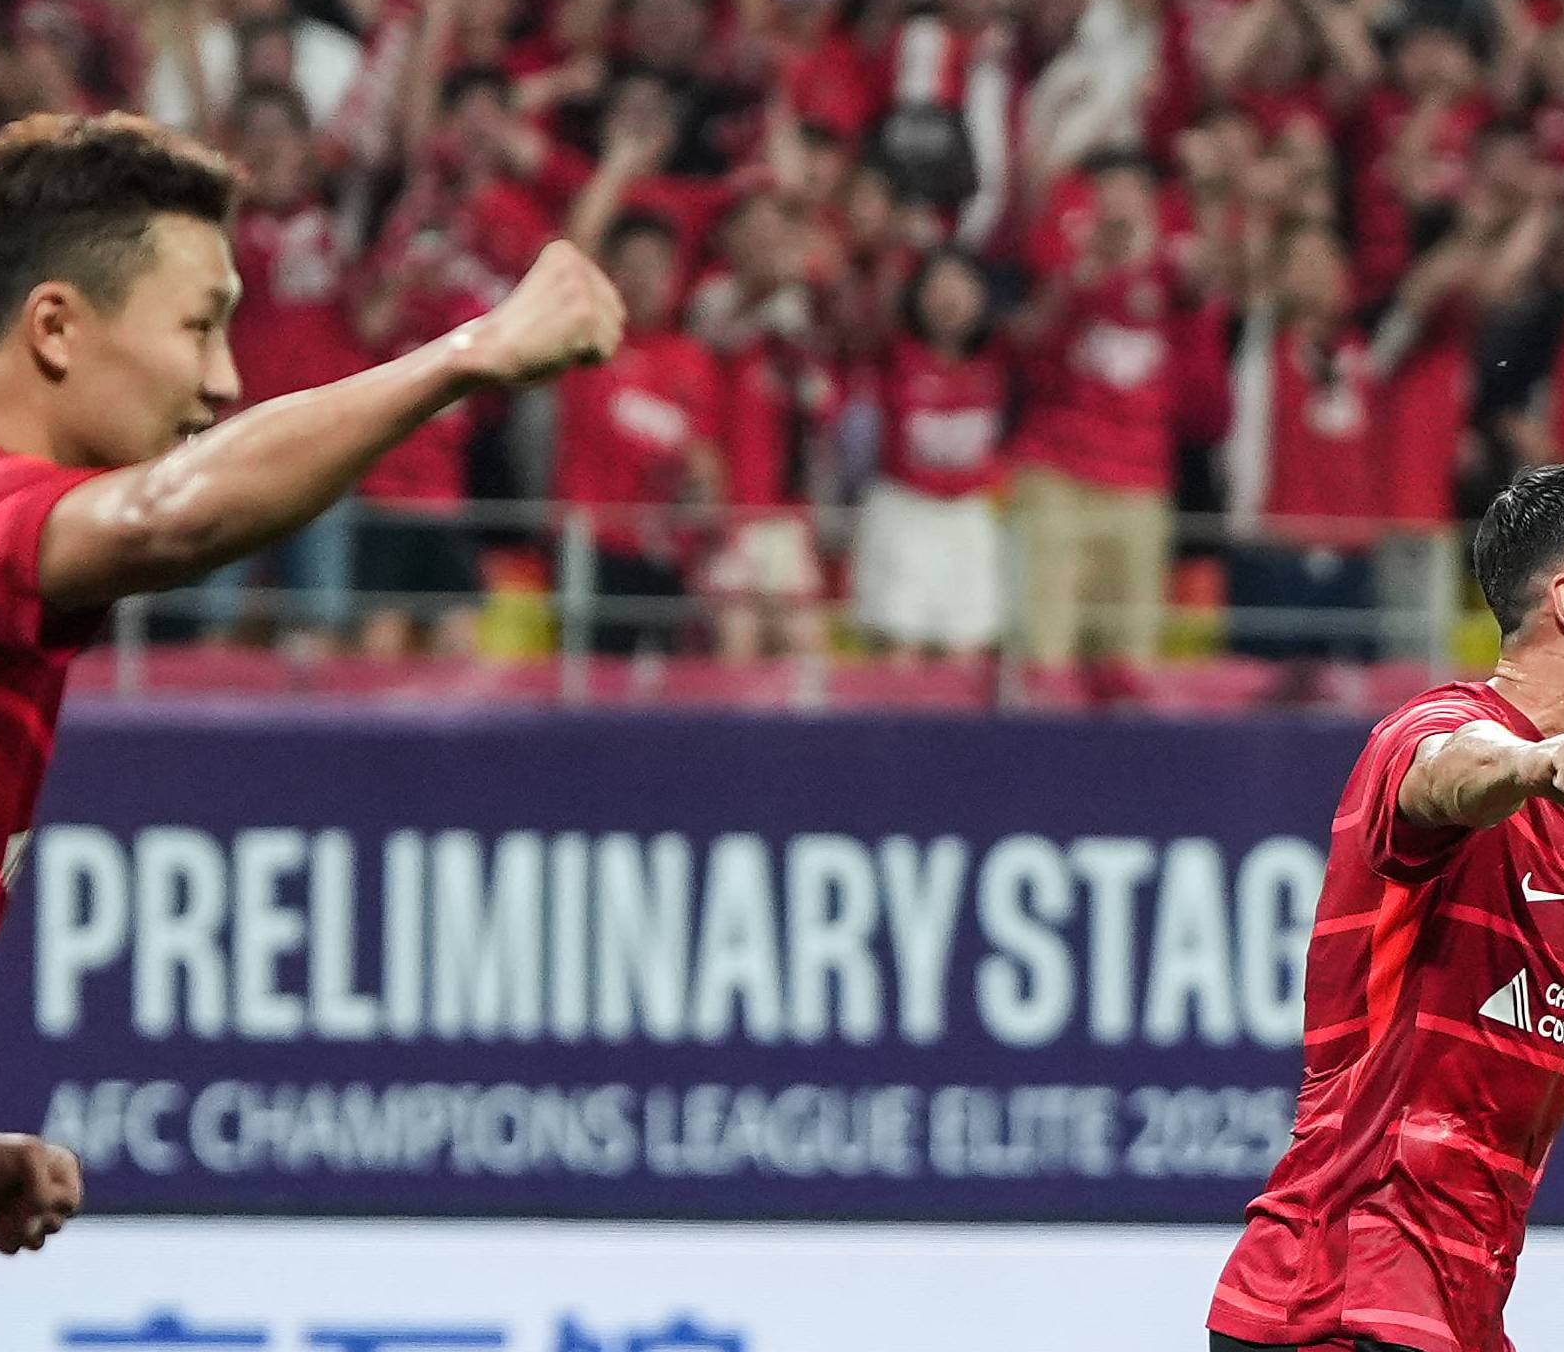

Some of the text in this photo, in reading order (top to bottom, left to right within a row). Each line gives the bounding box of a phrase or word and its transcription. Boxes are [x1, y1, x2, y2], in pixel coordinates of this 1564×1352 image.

[36, 826, 968, 1044] PRELIMINARY
[42, 1080, 182, 1174] AFC
[188, 1080, 634, 1176] CHAMPIONS
[642, 1082, 923, 1178] LEAGUE
[930, 1083, 1122, 1179] ELITE
